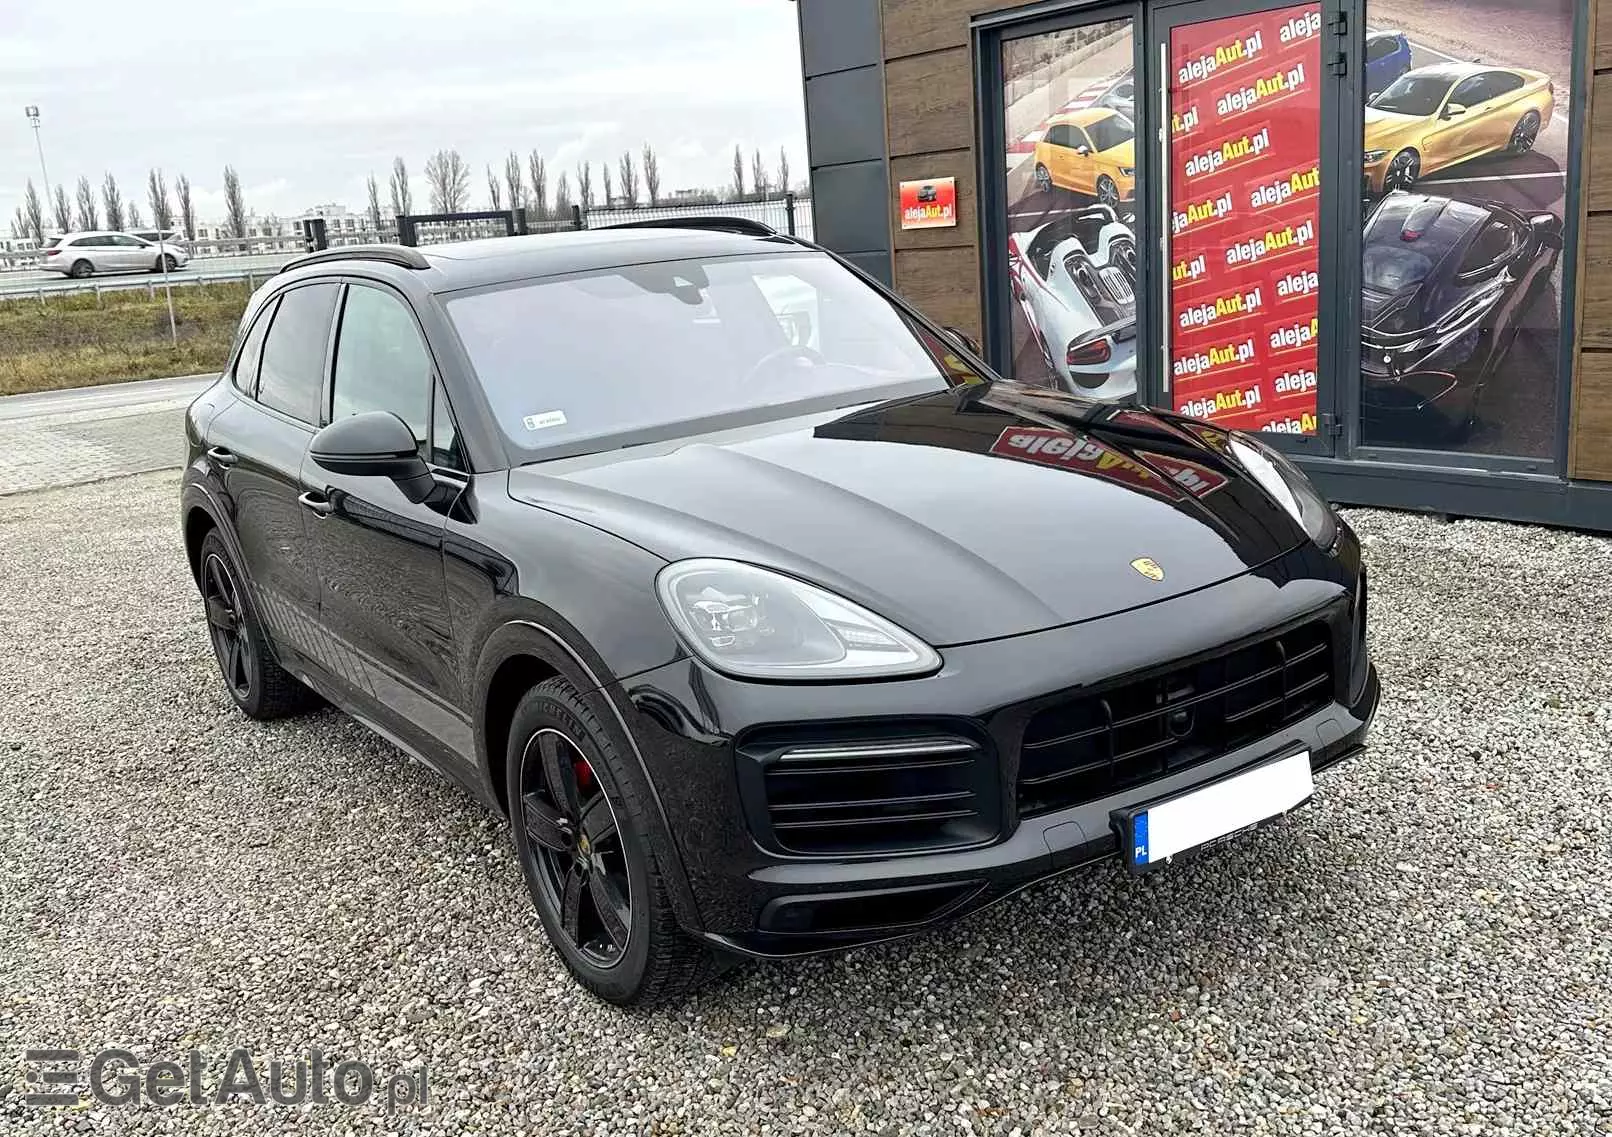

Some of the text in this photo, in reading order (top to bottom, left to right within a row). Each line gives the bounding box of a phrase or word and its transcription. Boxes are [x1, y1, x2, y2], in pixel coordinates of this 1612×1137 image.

[1279, 11, 1321, 42] aleja
[1178, 30, 1263, 84] alejaAut.pl
[1216, 62, 1305, 116] alejaAut.pl
[1184, 127, 1270, 177] alejaAut.pl
[1226, 219, 1314, 265] alejaAut.pl
[1276, 270, 1318, 296] aleja
[1179, 287, 1262, 328] alejaAut.pl
[1173, 338, 1255, 376] alejaAut.pl
[1180, 384, 1262, 419] alejaAut.pl
[1135, 845, 1147, 858] PL
